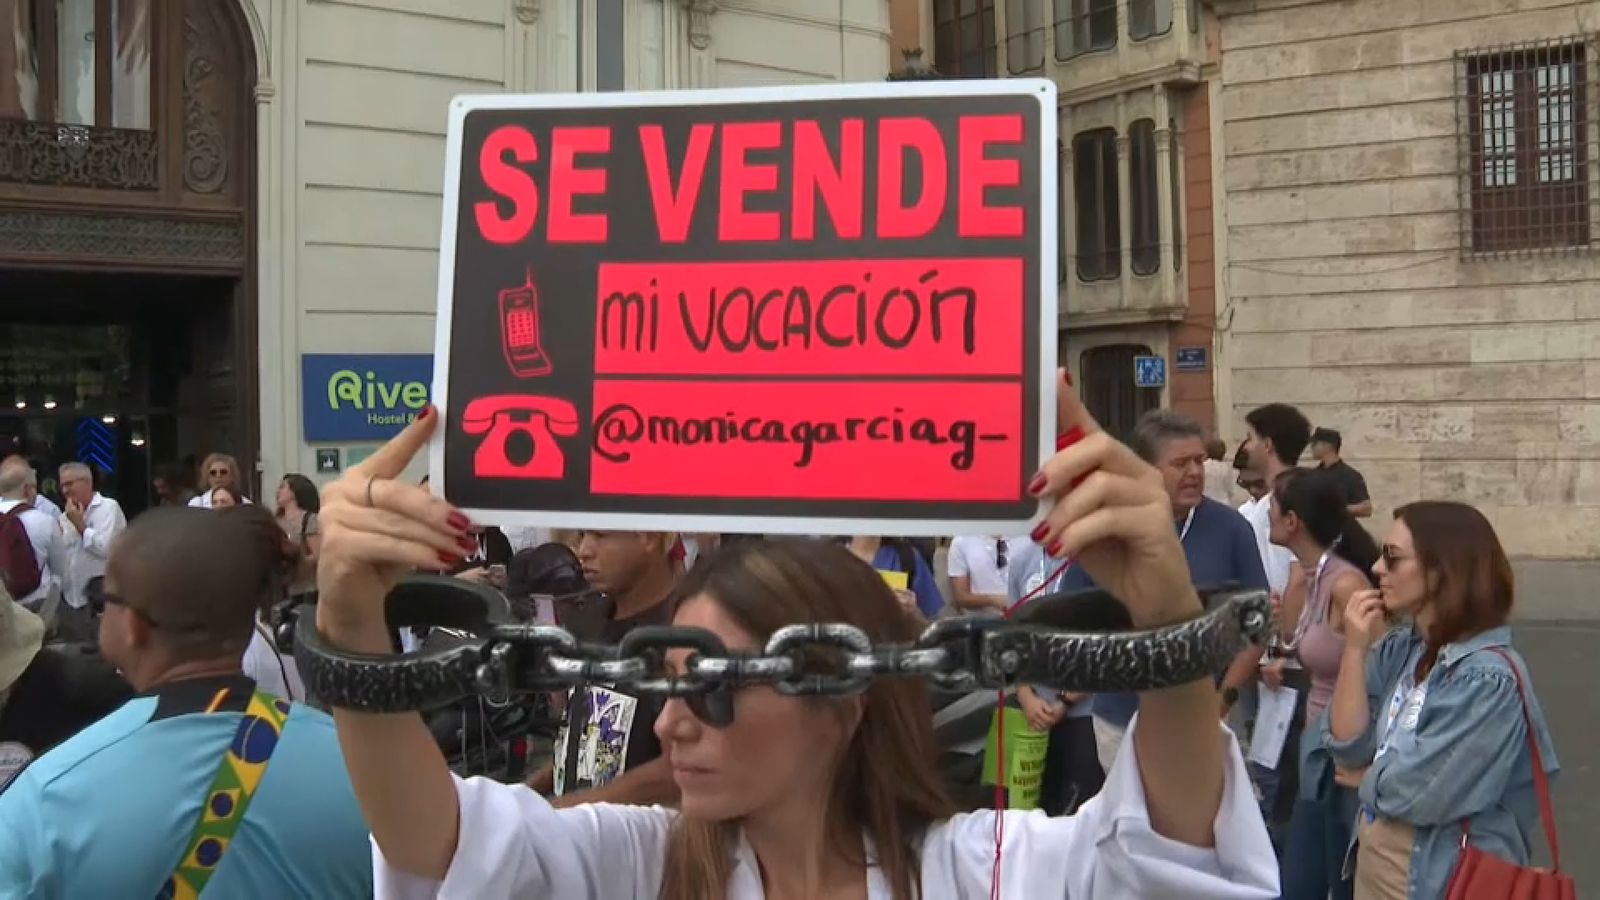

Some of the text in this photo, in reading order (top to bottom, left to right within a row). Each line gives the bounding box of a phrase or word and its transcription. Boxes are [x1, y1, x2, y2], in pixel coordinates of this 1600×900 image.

[475, 114, 1025, 244] SE VENDE
[602, 278, 659, 354] mi
[328, 371, 428, 409] Rive
[368, 414, 405, 425] Hostel
